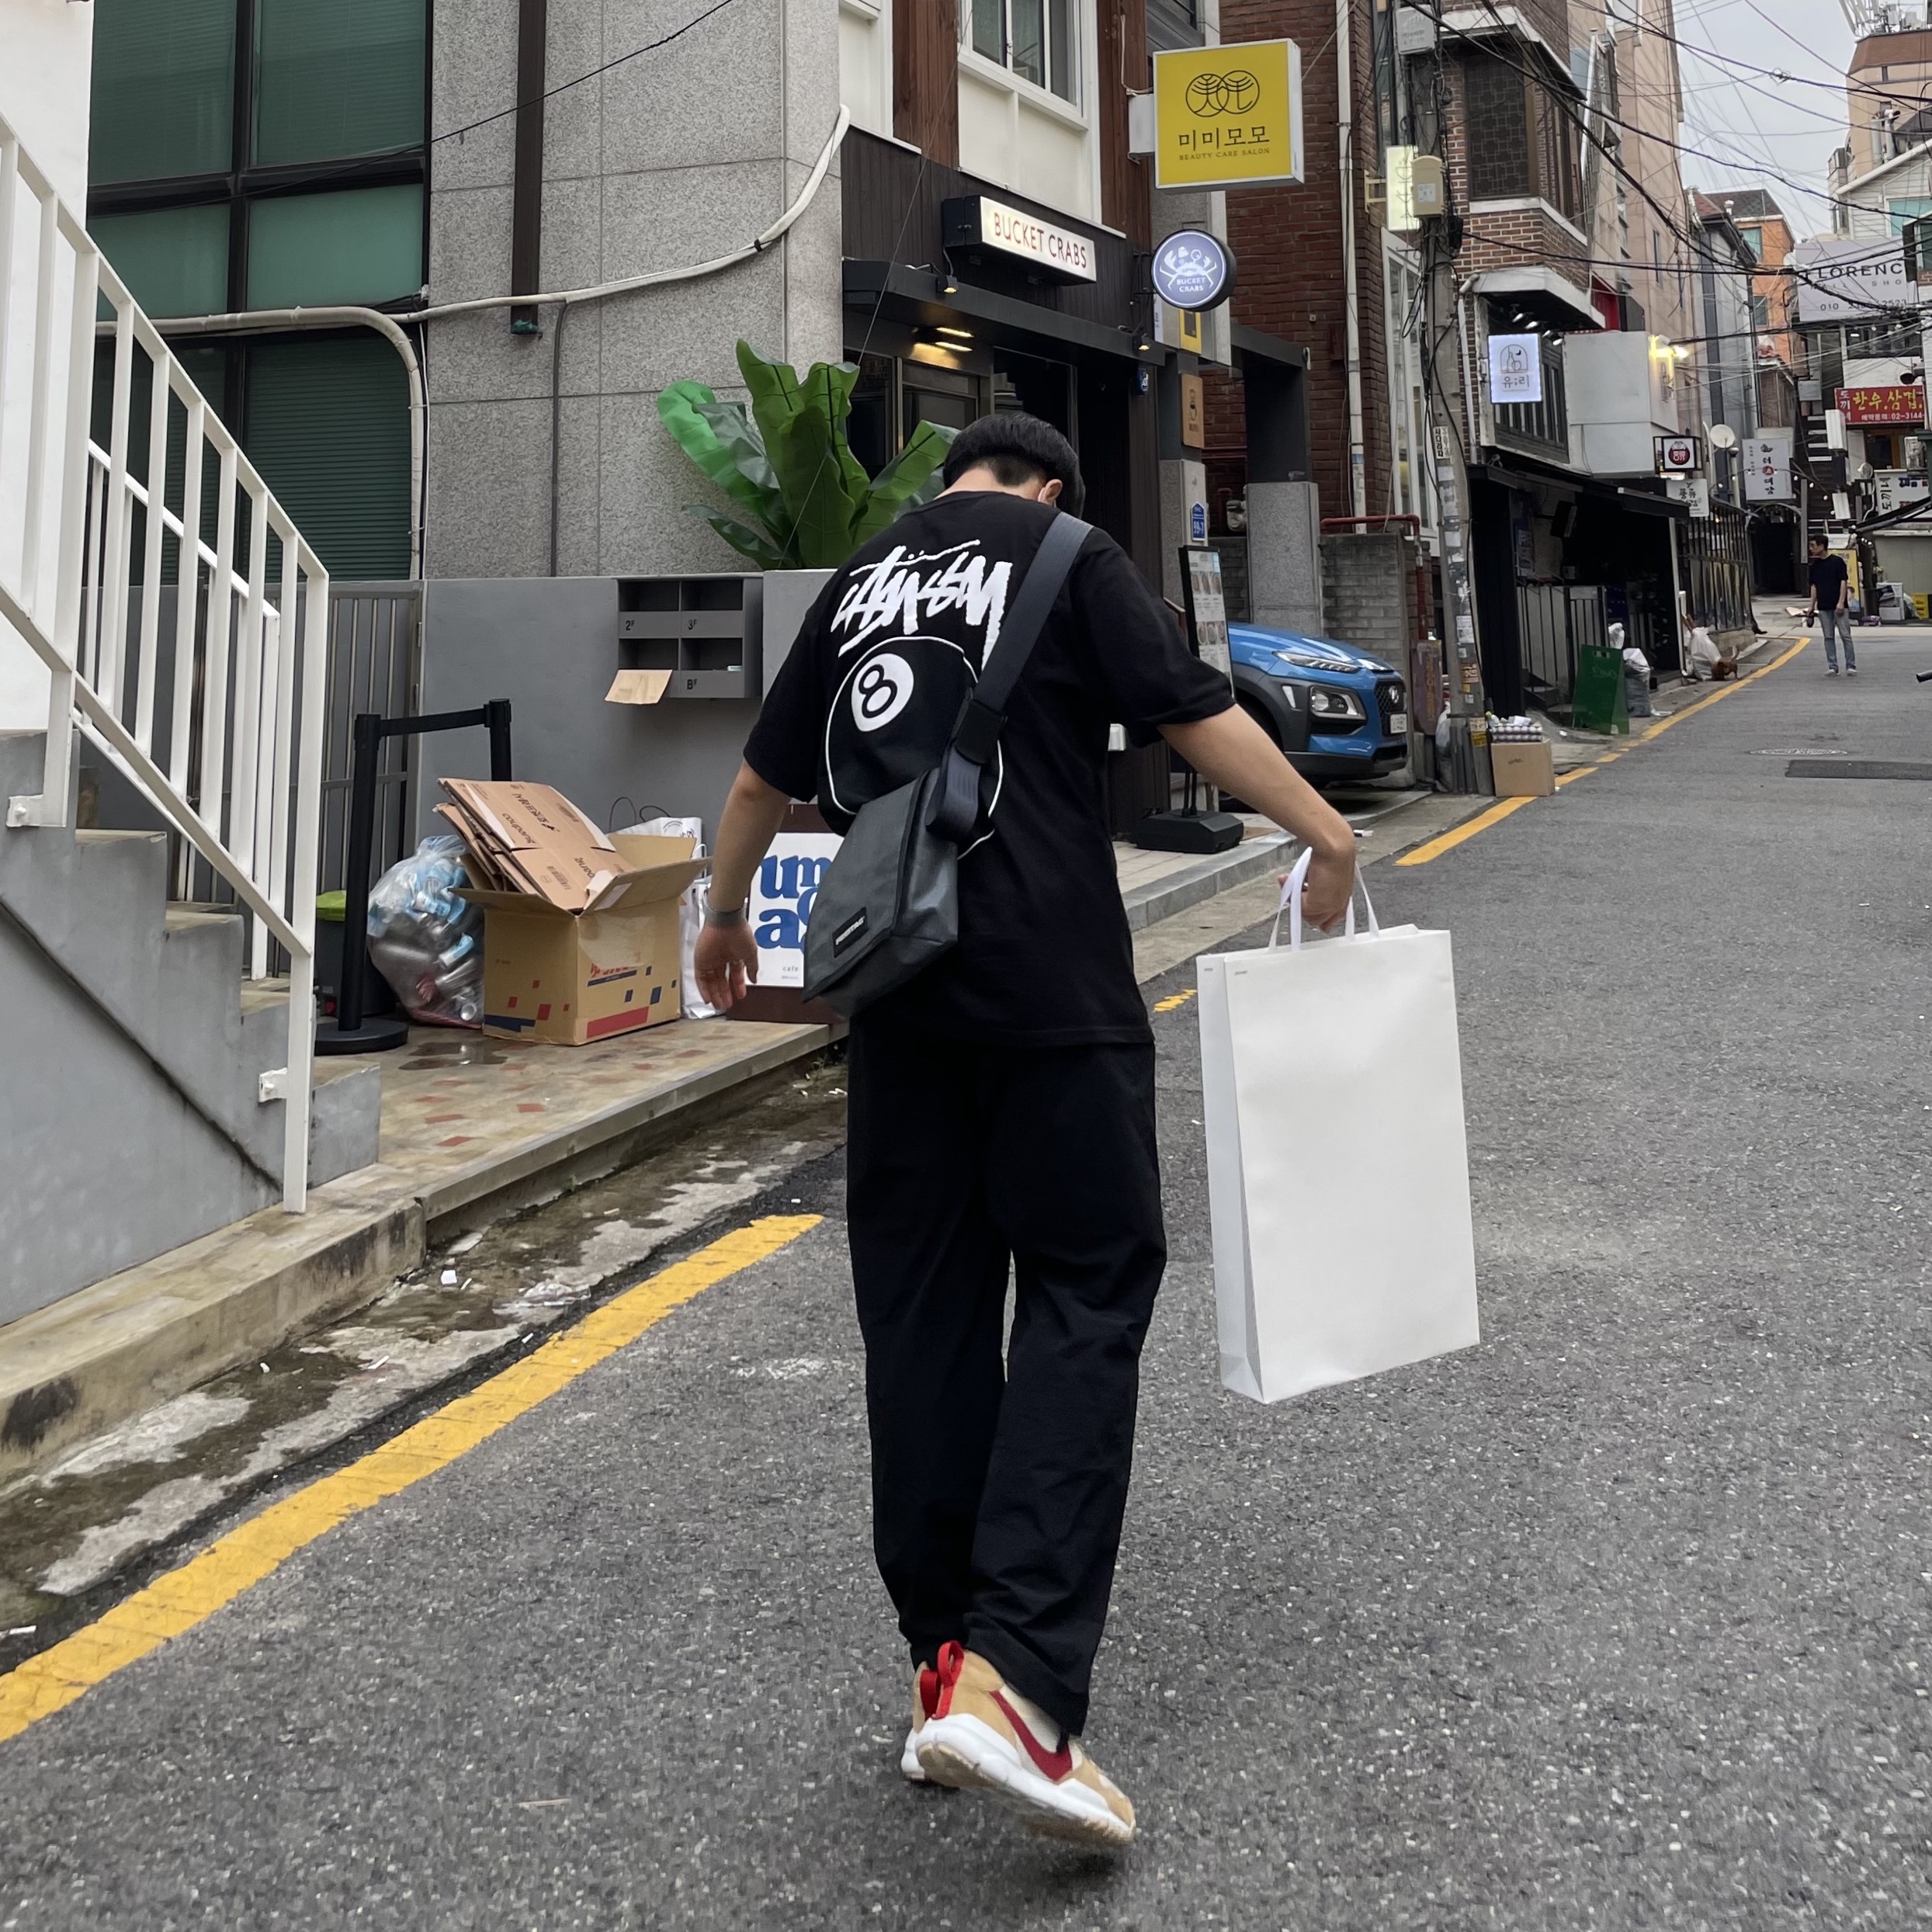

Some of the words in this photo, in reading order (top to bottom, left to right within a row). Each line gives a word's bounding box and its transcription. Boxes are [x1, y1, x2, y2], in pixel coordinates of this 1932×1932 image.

[1178, 126, 1270, 151] 미미모모
[1179, 151, 1212, 161] BEAUTY
[1216, 150, 1238, 158] CARE
[1241, 147, 1270, 156] SALON
[994, 212, 1045, 253] BUCKET
[1048, 234, 1087, 269] CRABS
[1178, 284, 1204, 293] CRABS
[1819, 302, 1840, 311] 010
[625, 619, 636, 631] 2F
[688, 619, 697, 630] 3F
[686, 678, 698, 690] BF
